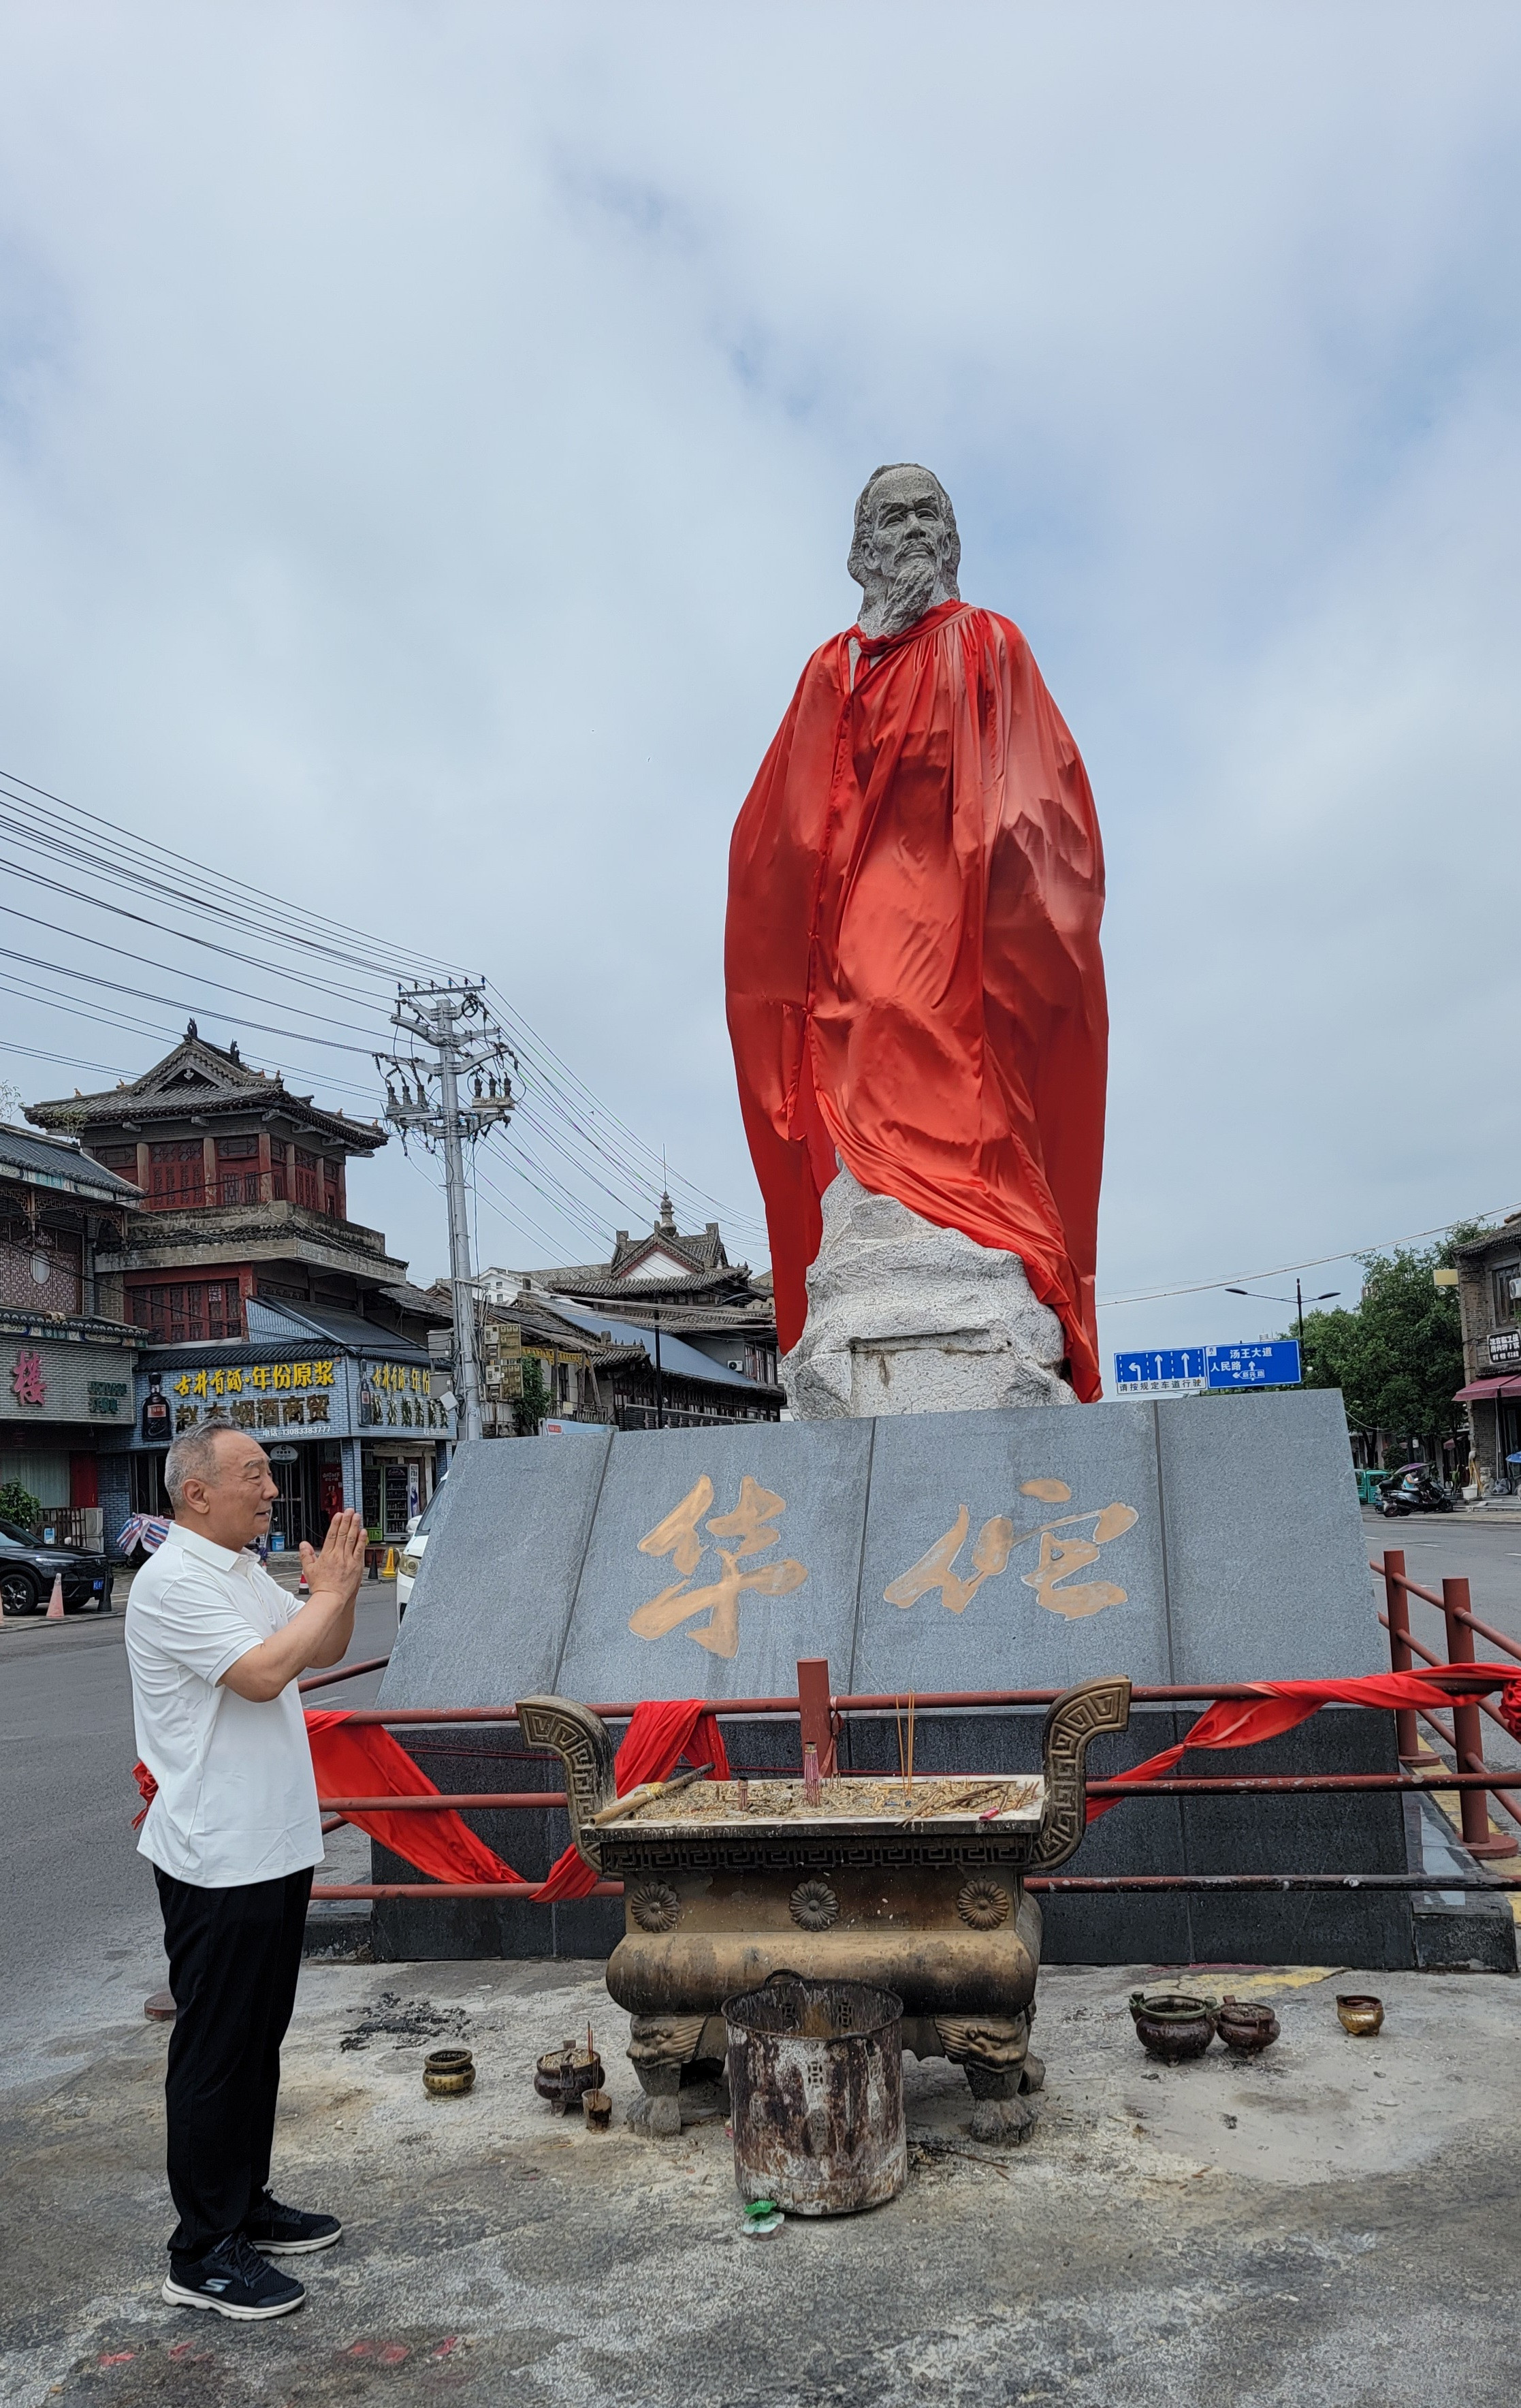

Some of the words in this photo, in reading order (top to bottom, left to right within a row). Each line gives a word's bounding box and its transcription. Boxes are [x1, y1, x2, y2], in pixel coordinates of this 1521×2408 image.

[1230, 1347, 1272, 1359] 汤王大道
[1210, 1361, 1241, 1372] 人民路
[1119, 1378, 1202, 1392] 请按规定车道行驶
